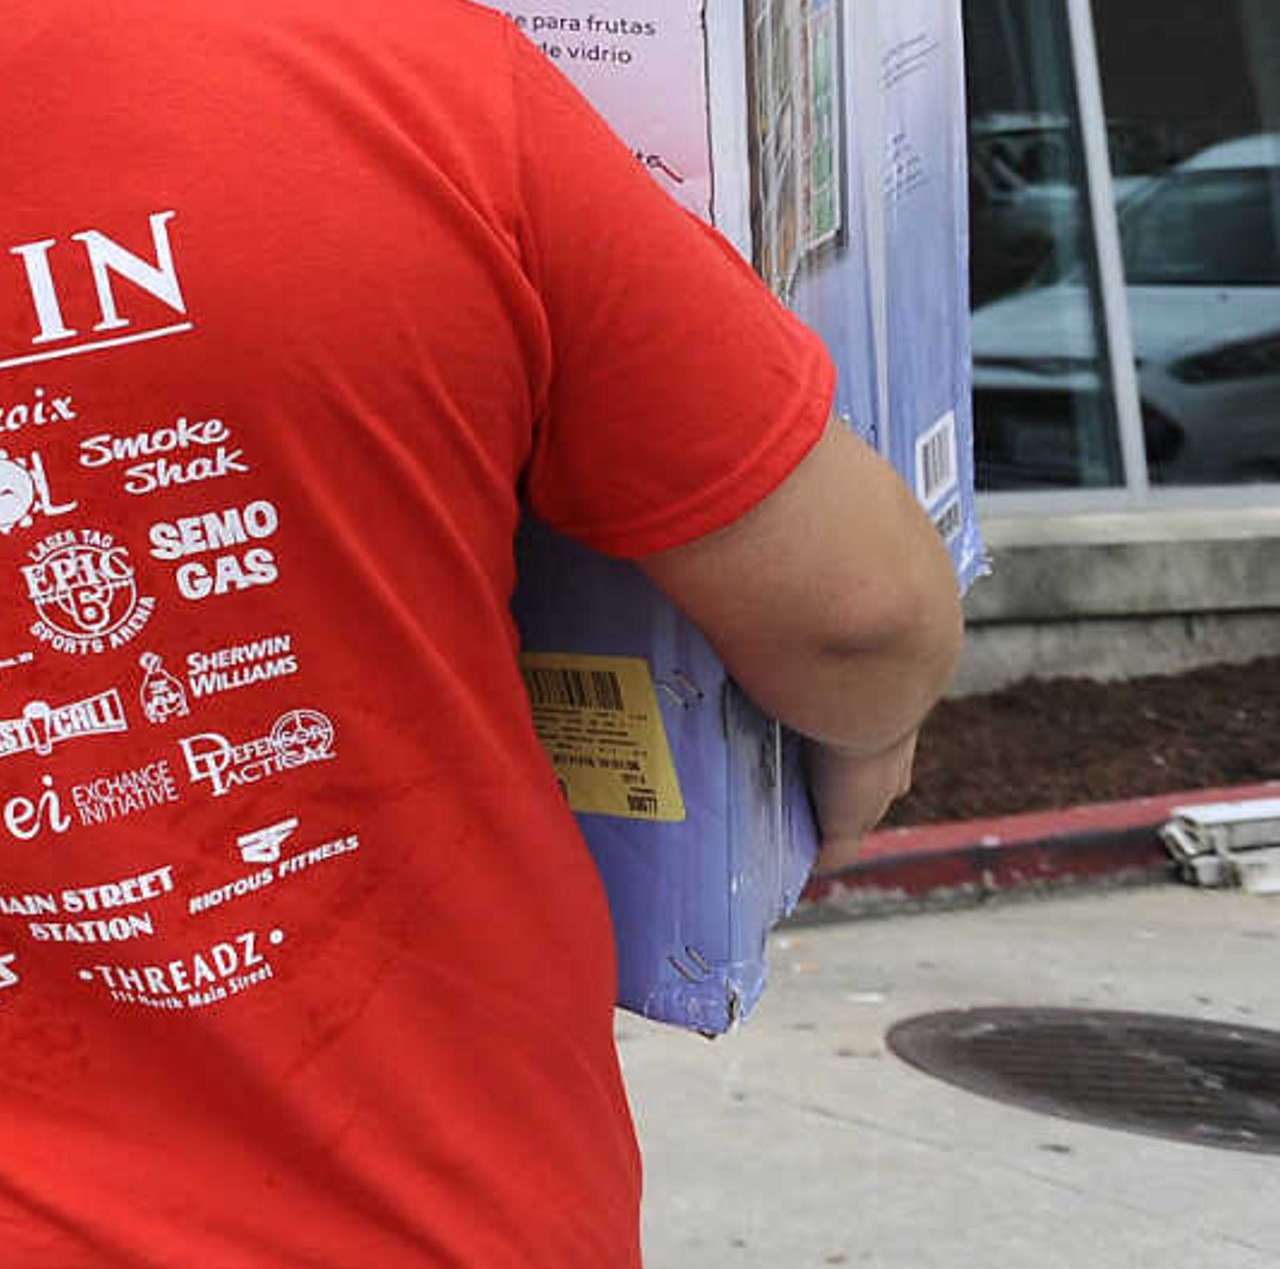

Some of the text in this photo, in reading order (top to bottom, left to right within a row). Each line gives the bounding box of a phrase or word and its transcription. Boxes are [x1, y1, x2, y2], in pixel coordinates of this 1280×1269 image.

[532, 14, 582, 33] para
[587, 13, 657, 36] frutas
[567, 41, 633, 64] vidrio
[10, 209, 187, 345] IN
[80, 417, 231, 468] Smoke
[123, 446, 250, 495] Shak
[149, 500, 279, 560] SEMO
[22, 543, 135, 602] EPIC
[175, 548, 279, 601] GAS
[29, 594, 157, 655] SPORTS ARENA
[186, 635, 292, 675] SHERWIN
[190, 655, 299, 698] WILLIAMS
[52, 694, 123, 735] CALL
[2, 775, 72, 840] ei
[71, 760, 171, 808] EXCHANGE
[77, 782, 179, 826] INITIATIVE
[61, 864, 174, 914] STREET
[188, 833, 360, 916] RIOTOUS FITNESS
[28, 911, 154, 944] STATION
[186, 984, 227, 1009] Main
[228, 962, 273, 995] Street
